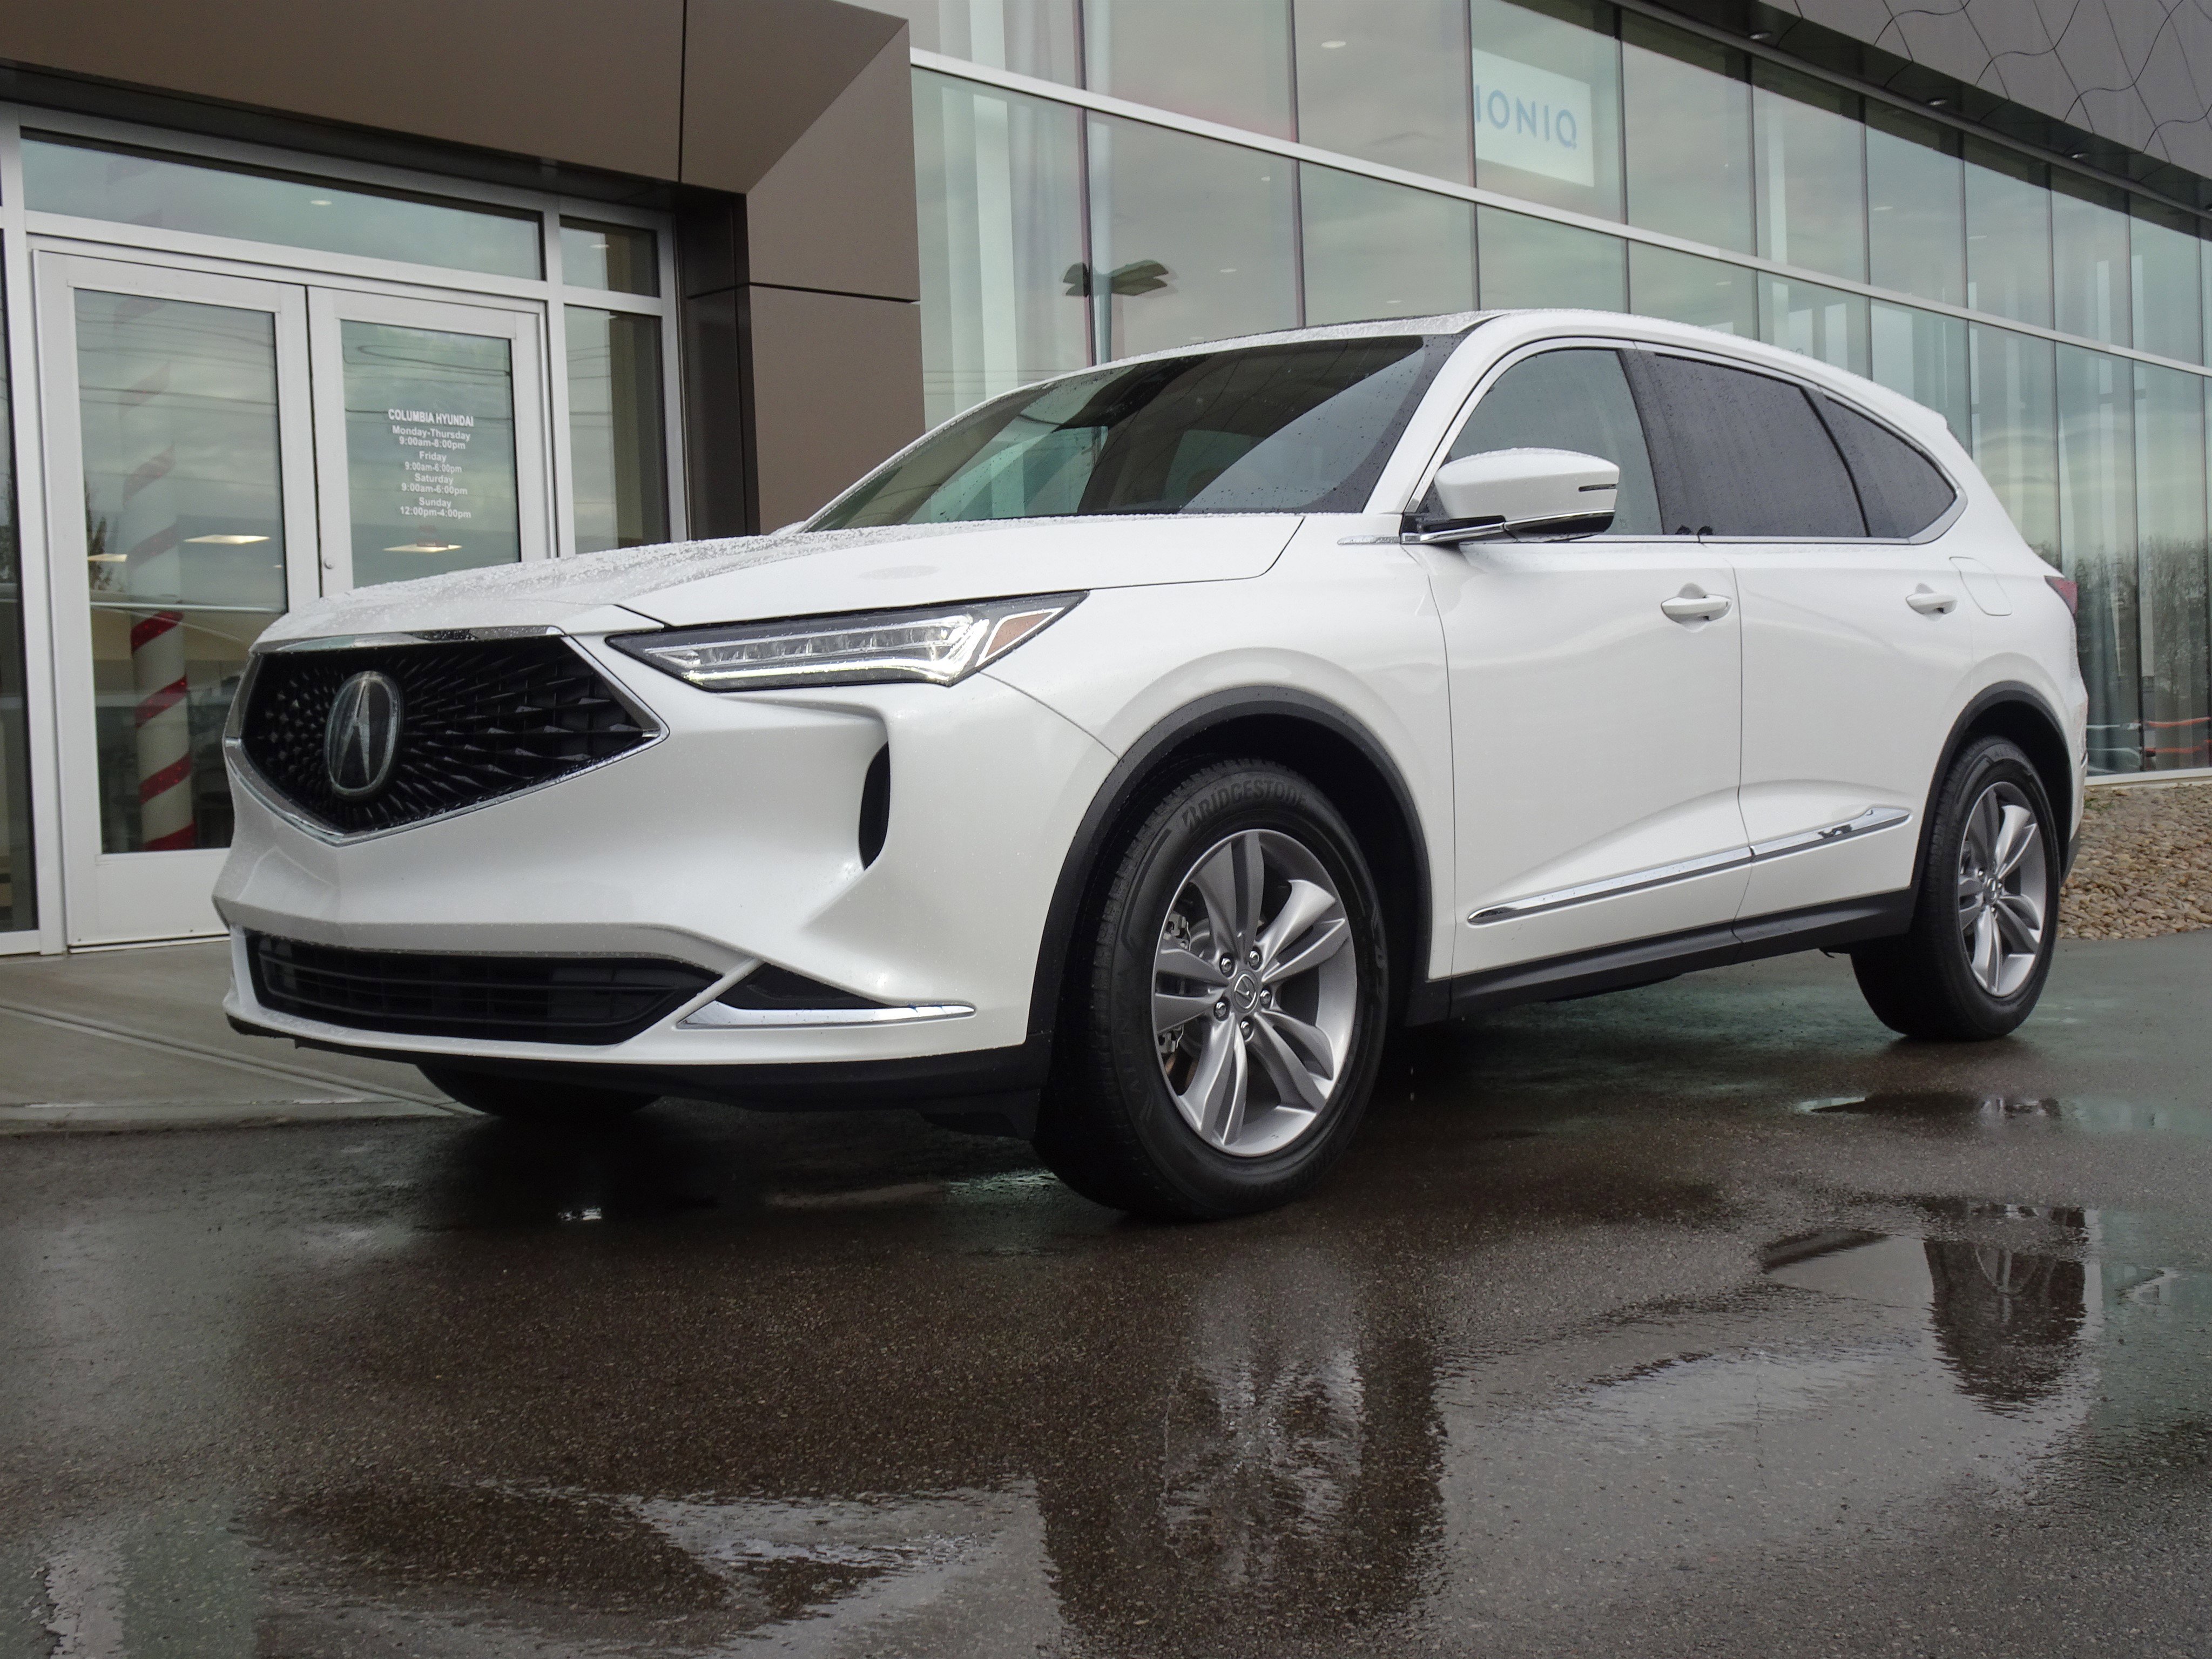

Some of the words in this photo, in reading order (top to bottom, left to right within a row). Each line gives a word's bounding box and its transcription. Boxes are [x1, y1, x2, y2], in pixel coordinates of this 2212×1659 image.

[1475, 84, 1577, 150] IONIQ
[388, 409, 434, 423] COLUMBIA
[435, 413, 474, 427] HYUNDAI
[392, 425, 471, 442] Monday-Thursday
[399, 436, 466, 450] 9:00am-8:00pm
[419, 450, 447, 462] Friday
[404, 461, 462, 474] 9:00am-6:00pm
[415, 473, 454, 485] Saturday
[401, 483, 468, 496] 9:00am-6:00pm
[419, 496, 452, 509] Sunday
[400, 505, 471, 519] 12:00pm-4:00pm
